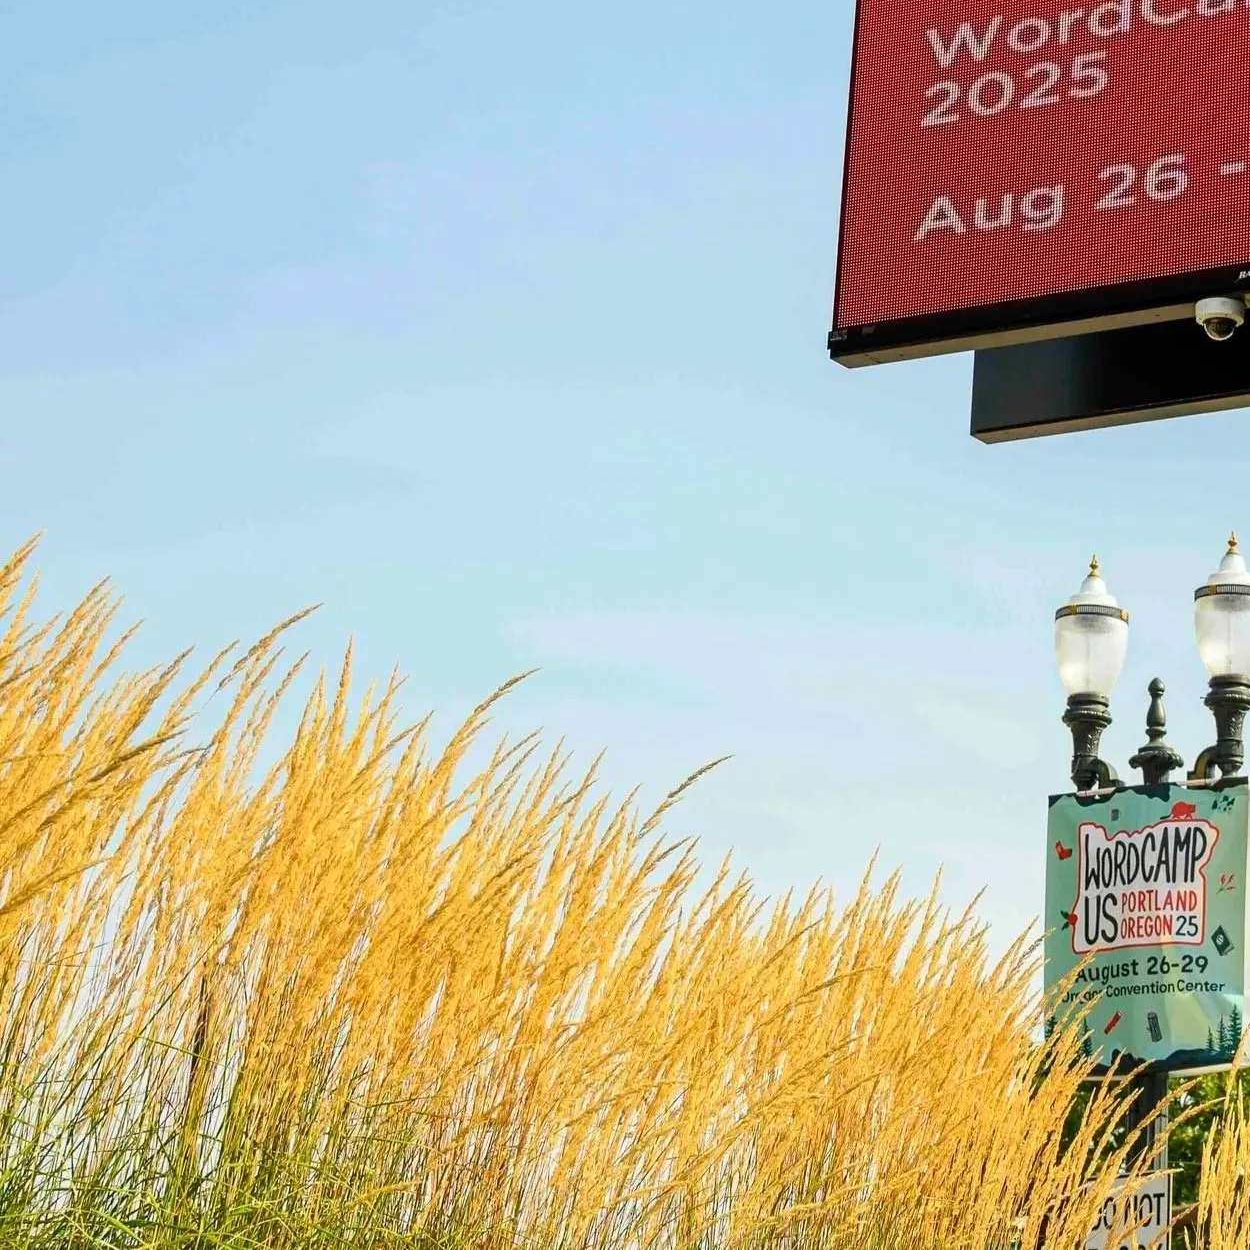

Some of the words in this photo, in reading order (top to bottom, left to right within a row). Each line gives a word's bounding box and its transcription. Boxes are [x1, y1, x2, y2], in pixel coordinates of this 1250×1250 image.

[920, 50, 1110, 127] 2025
[913, 177, 1065, 241] Aug
[1095, 152, 1188, 211] 26
[1218, 159, 1247, 173] -
[1084, 826, 1207, 891] WORDCAMP
[1084, 892, 1118, 945] US
[1121, 889, 1198, 914] PORTLAND
[1120, 916, 1173, 940] OREGON
[1175, 915, 1199, 937] 25
[1075, 958, 1139, 985] August
[1146, 954, 1209, 975] 26-29
[1106, 980, 1175, 998] Convention
[1176, 979, 1226, 993] Center
[1123, 1192, 1165, 1228] NOT
